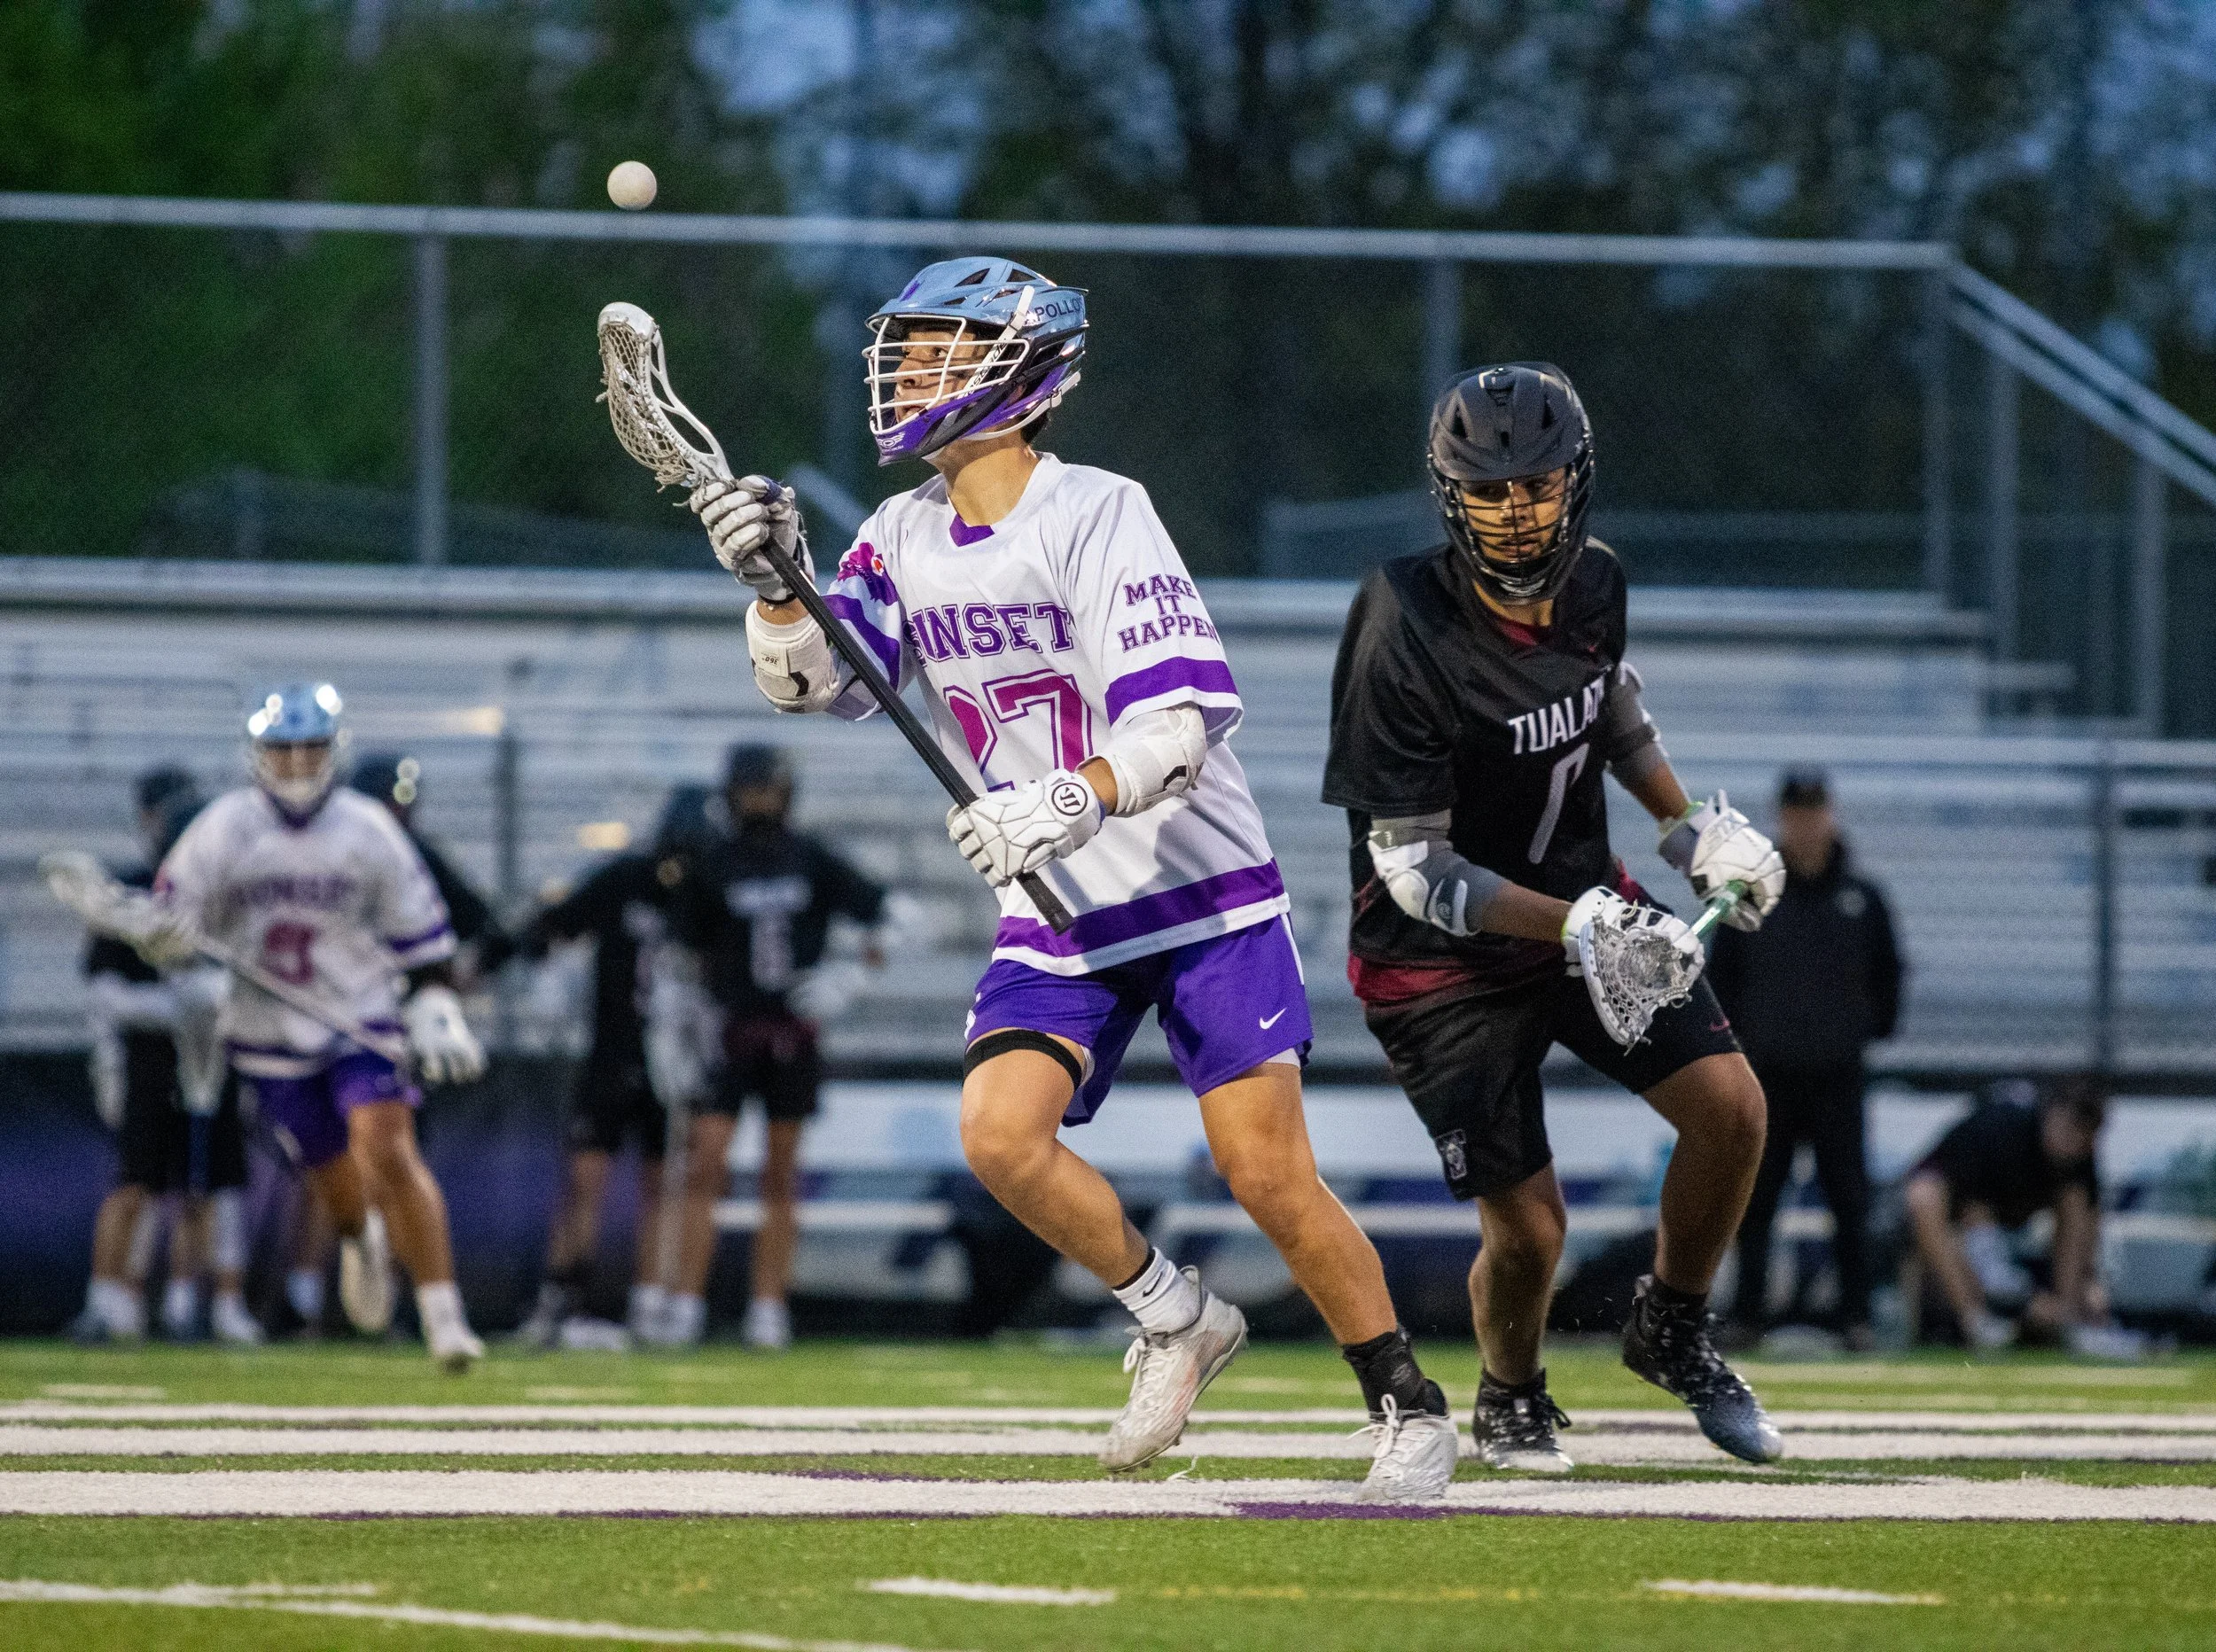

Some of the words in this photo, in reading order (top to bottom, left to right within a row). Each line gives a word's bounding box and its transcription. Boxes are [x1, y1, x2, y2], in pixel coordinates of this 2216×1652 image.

[1024, 296, 1083, 324] POLLO
[1123, 573, 1198, 607] MAKE
[1154, 594, 1181, 616] IT
[1117, 613, 1221, 653] HAPPEN
